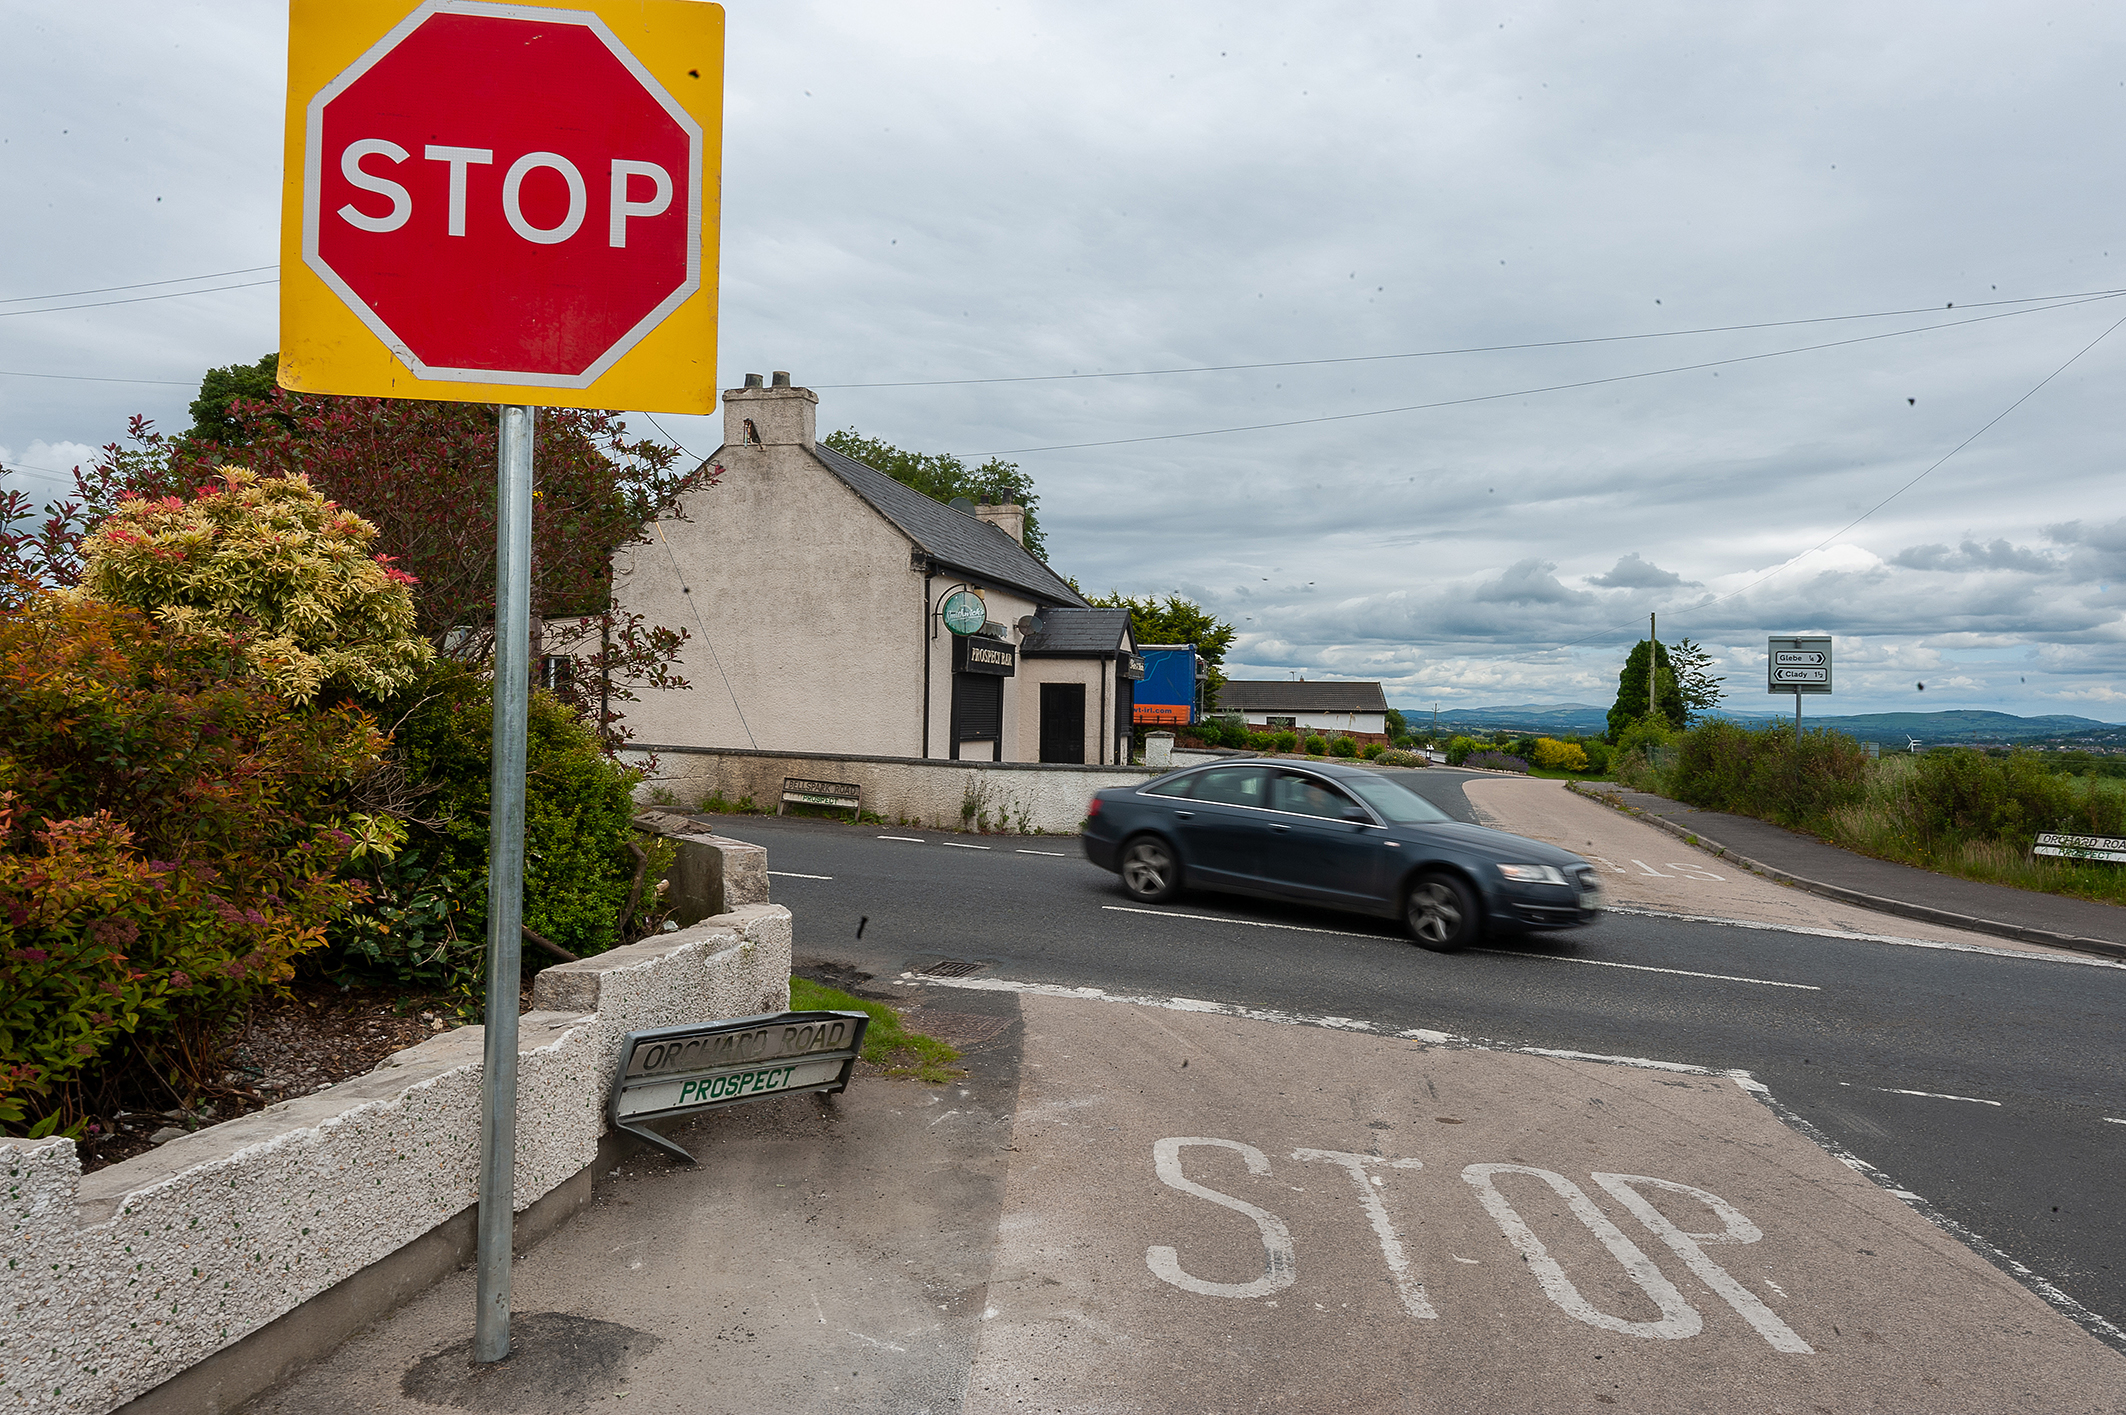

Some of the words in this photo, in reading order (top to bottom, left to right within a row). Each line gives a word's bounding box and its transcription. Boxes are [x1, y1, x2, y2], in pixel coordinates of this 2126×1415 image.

[336, 138, 674, 249] STOP
[971, 647, 1000, 665] PROSPECT
[1001, 652, 1013, 667] BAR
[1779, 654, 1802, 662] Glebe
[1785, 671, 1808, 679] Clady
[788, 780, 831, 793] BELLSPARK
[834, 785, 857, 795] ROAD
[802, 794, 838, 805] PROSPECT
[643, 1030, 769, 1071] ORCHARD
[781, 1022, 846, 1051] ROAD
[678, 1066, 796, 1104] PROSPECT
[1145, 1136, 1817, 1355] STOP
